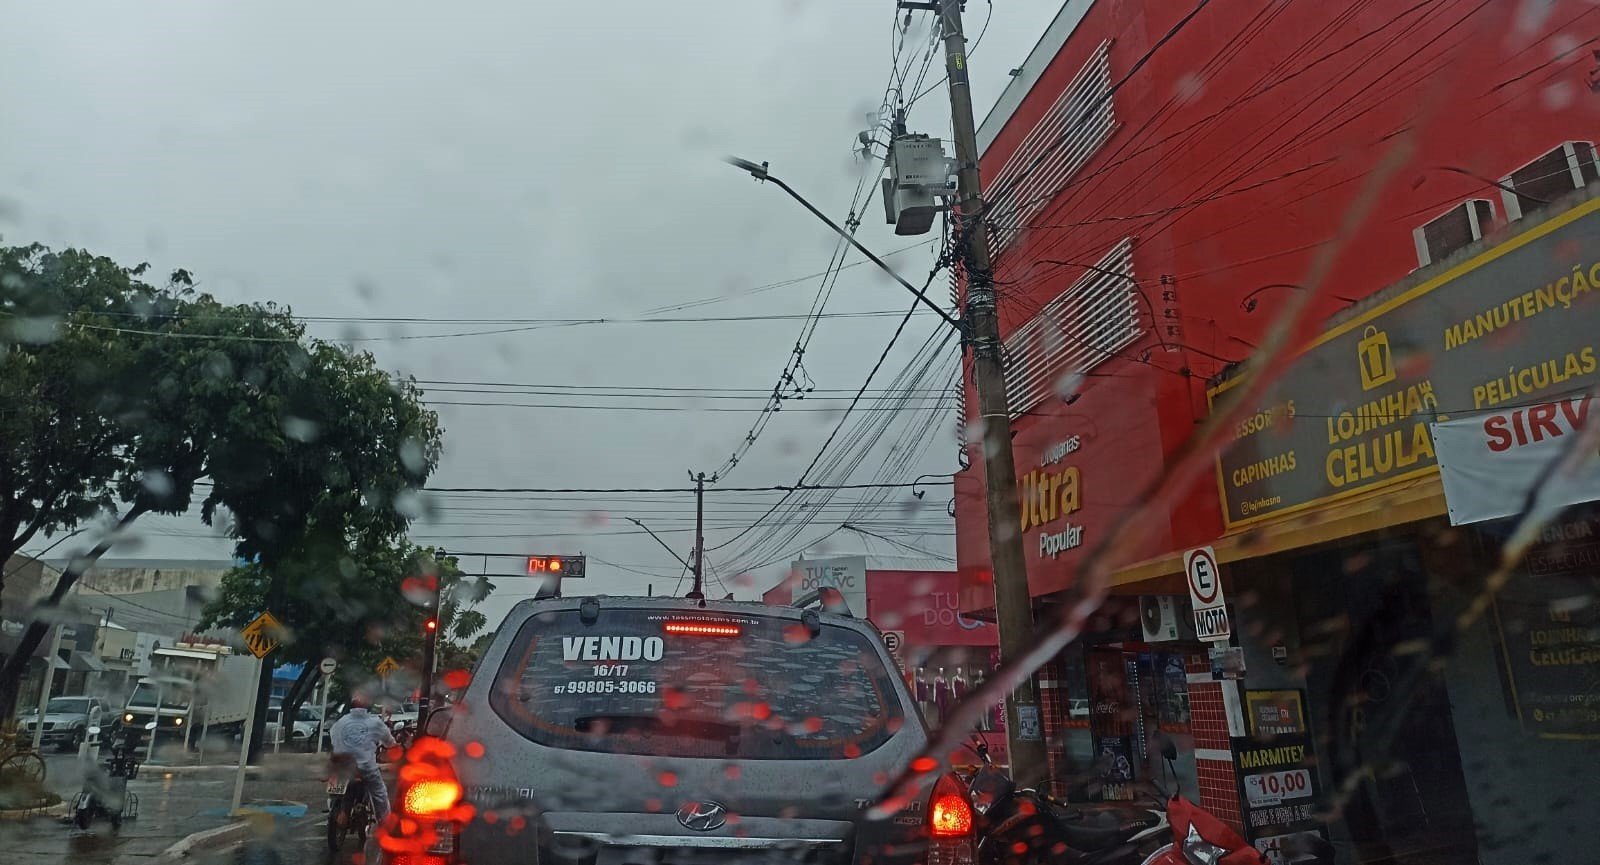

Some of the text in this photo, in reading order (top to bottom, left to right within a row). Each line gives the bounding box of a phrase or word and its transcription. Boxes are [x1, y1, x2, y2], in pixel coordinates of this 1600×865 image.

[1473, 347, 1597, 410] PELÍCULAS
[1327, 386, 1424, 445] LOJINHA
[1326, 415, 1449, 487] CELULA
[1233, 451, 1297, 488] CAPINHAS
[1039, 524, 1083, 559] Popular
[528, 558, 546, 573] 04
[1197, 561, 1212, 589] E
[1195, 610, 1228, 637] MOTO
[562, 636, 664, 662] VENDO
[886, 636, 896, 648] E
[593, 664, 628, 677] 16/17
[554, 680, 656, 695] 67 99805-3066
[1240, 744, 1305, 769] MARMITEX
[1259, 772, 1305, 798] 10,00
